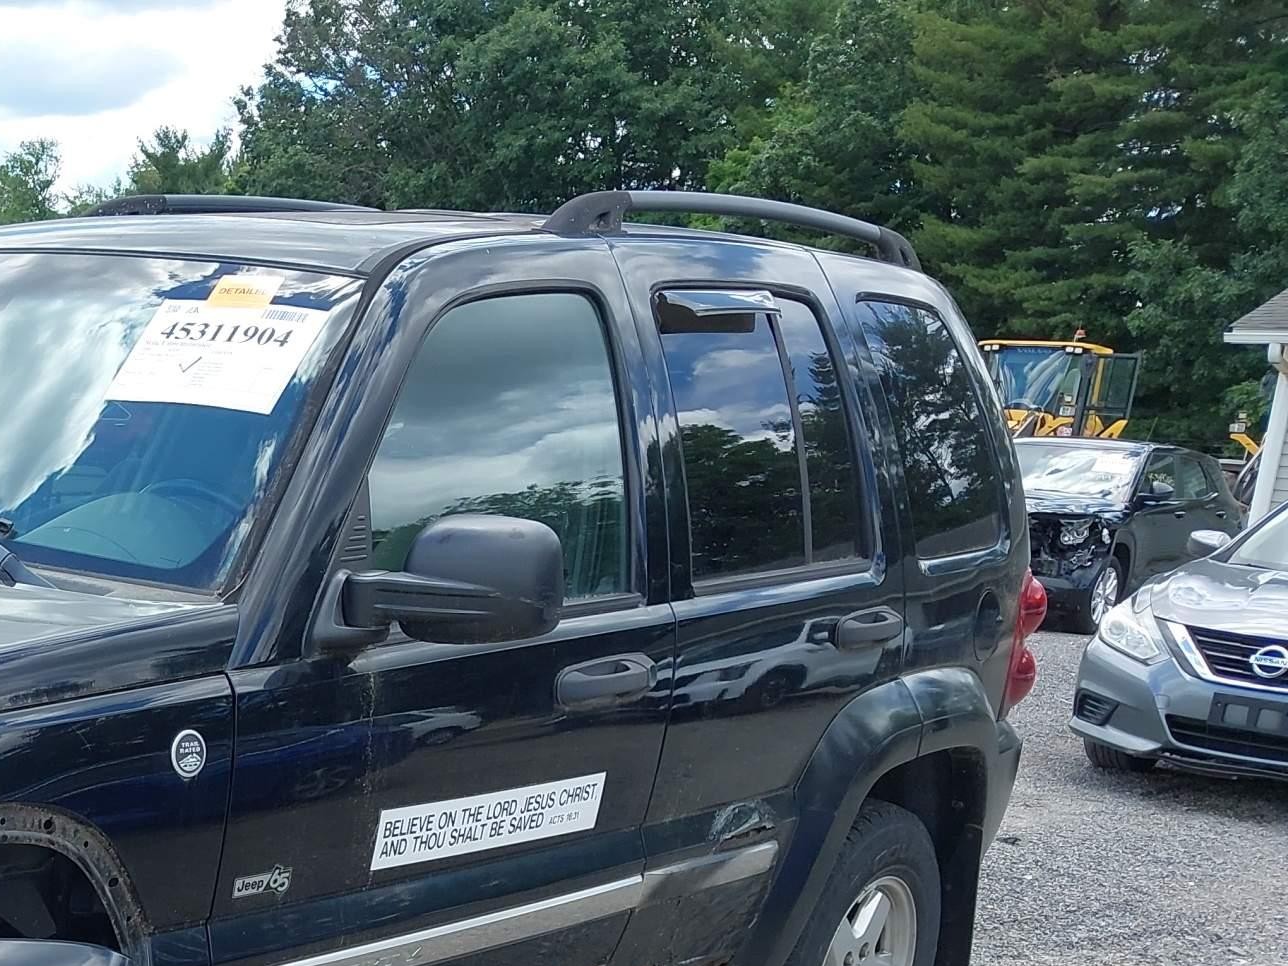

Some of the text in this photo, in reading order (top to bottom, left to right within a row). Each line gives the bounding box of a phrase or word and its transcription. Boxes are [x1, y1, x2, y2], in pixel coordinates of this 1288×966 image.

[161, 321, 294, 348] 45311904
[179, 746, 201, 754] RATED
[383, 814, 435, 839] BELIEVE
[438, 810, 458, 831] ON
[461, 805, 485, 825] THE
[486, 799, 518, 820] LORD
[520, 791, 557, 814] JESUS
[379, 838, 408, 859] AND
[413, 831, 447, 853] THOU
[448, 823, 487, 847] SHALT
[489, 820, 506, 838] BE
[508, 812, 545, 834] SAVED
[548, 814, 565, 825] ACTS
[237, 868, 290, 893] Jeep 65
